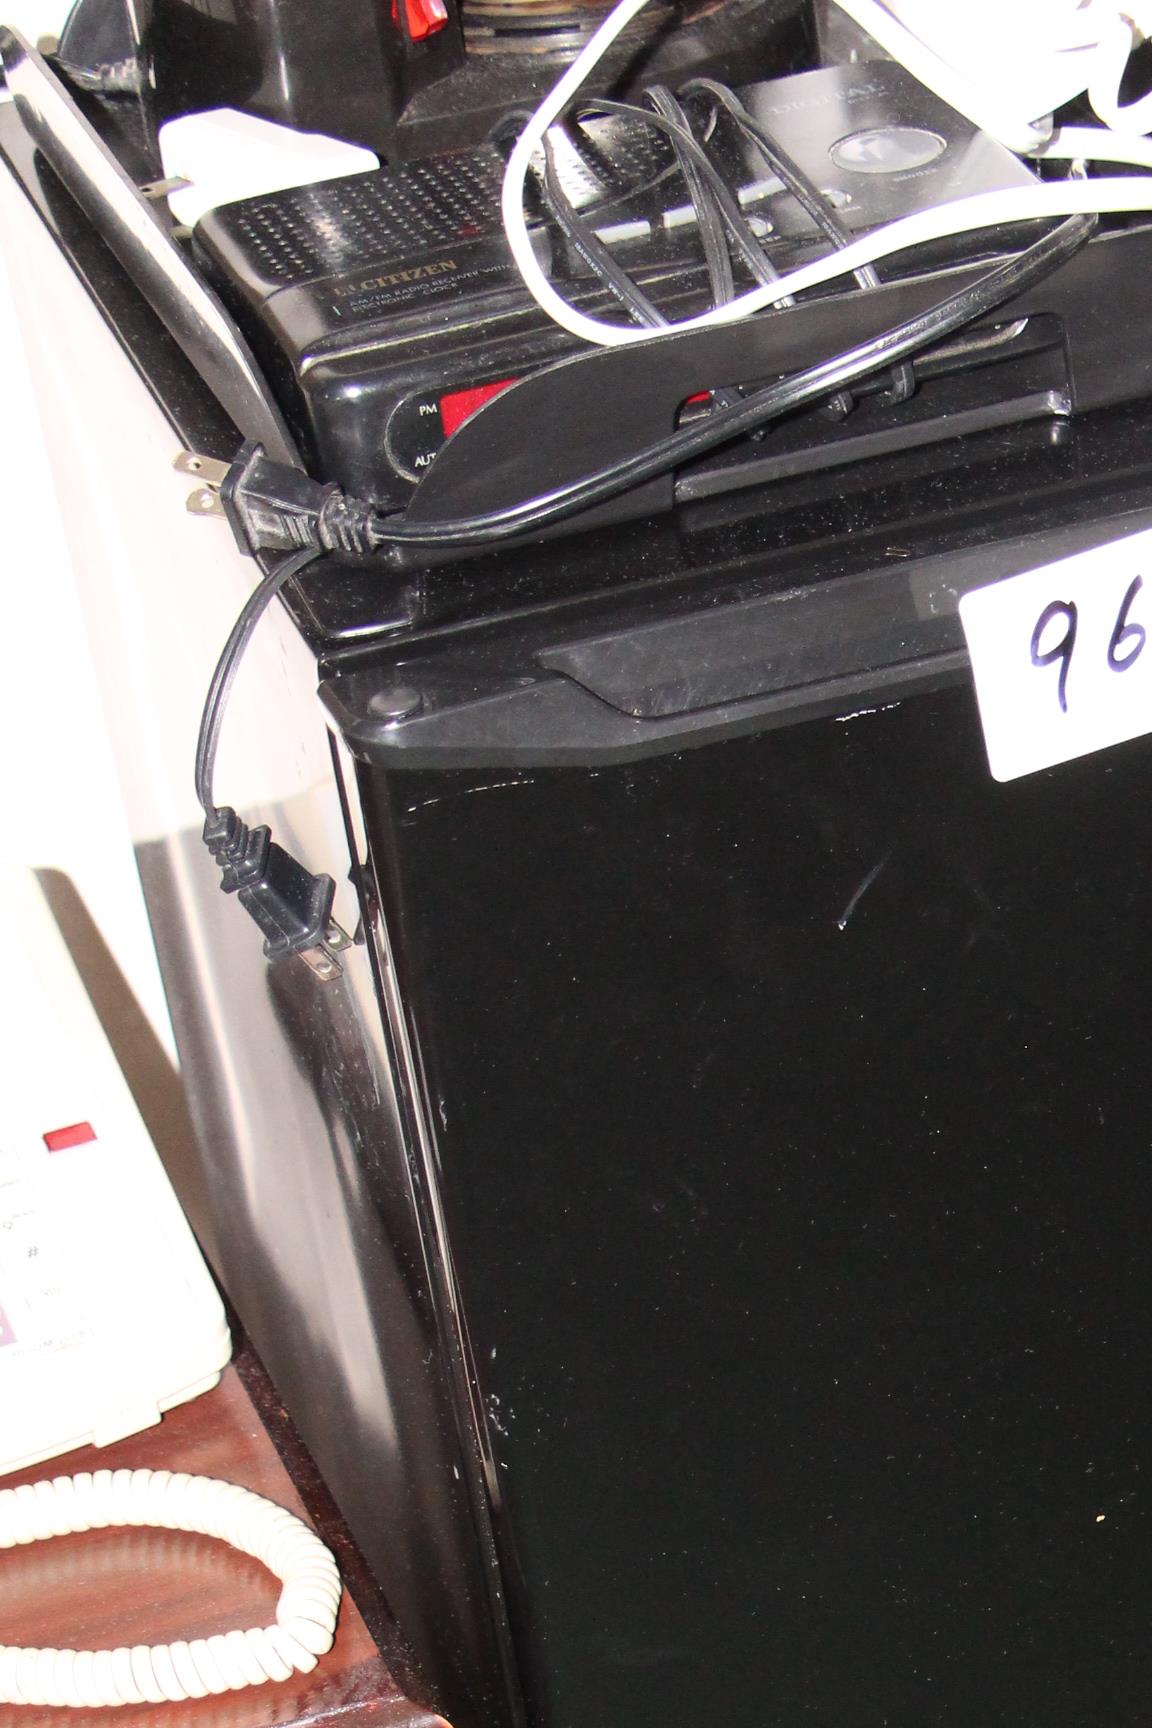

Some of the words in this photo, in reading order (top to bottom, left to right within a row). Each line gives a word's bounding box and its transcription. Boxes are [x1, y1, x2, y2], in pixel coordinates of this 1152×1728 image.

[360, 259, 457, 292] CITIZEN
[395, 283, 430, 298] RADIO
[432, 270, 479, 287] RECEIVER
[419, 403, 438, 416] PM
